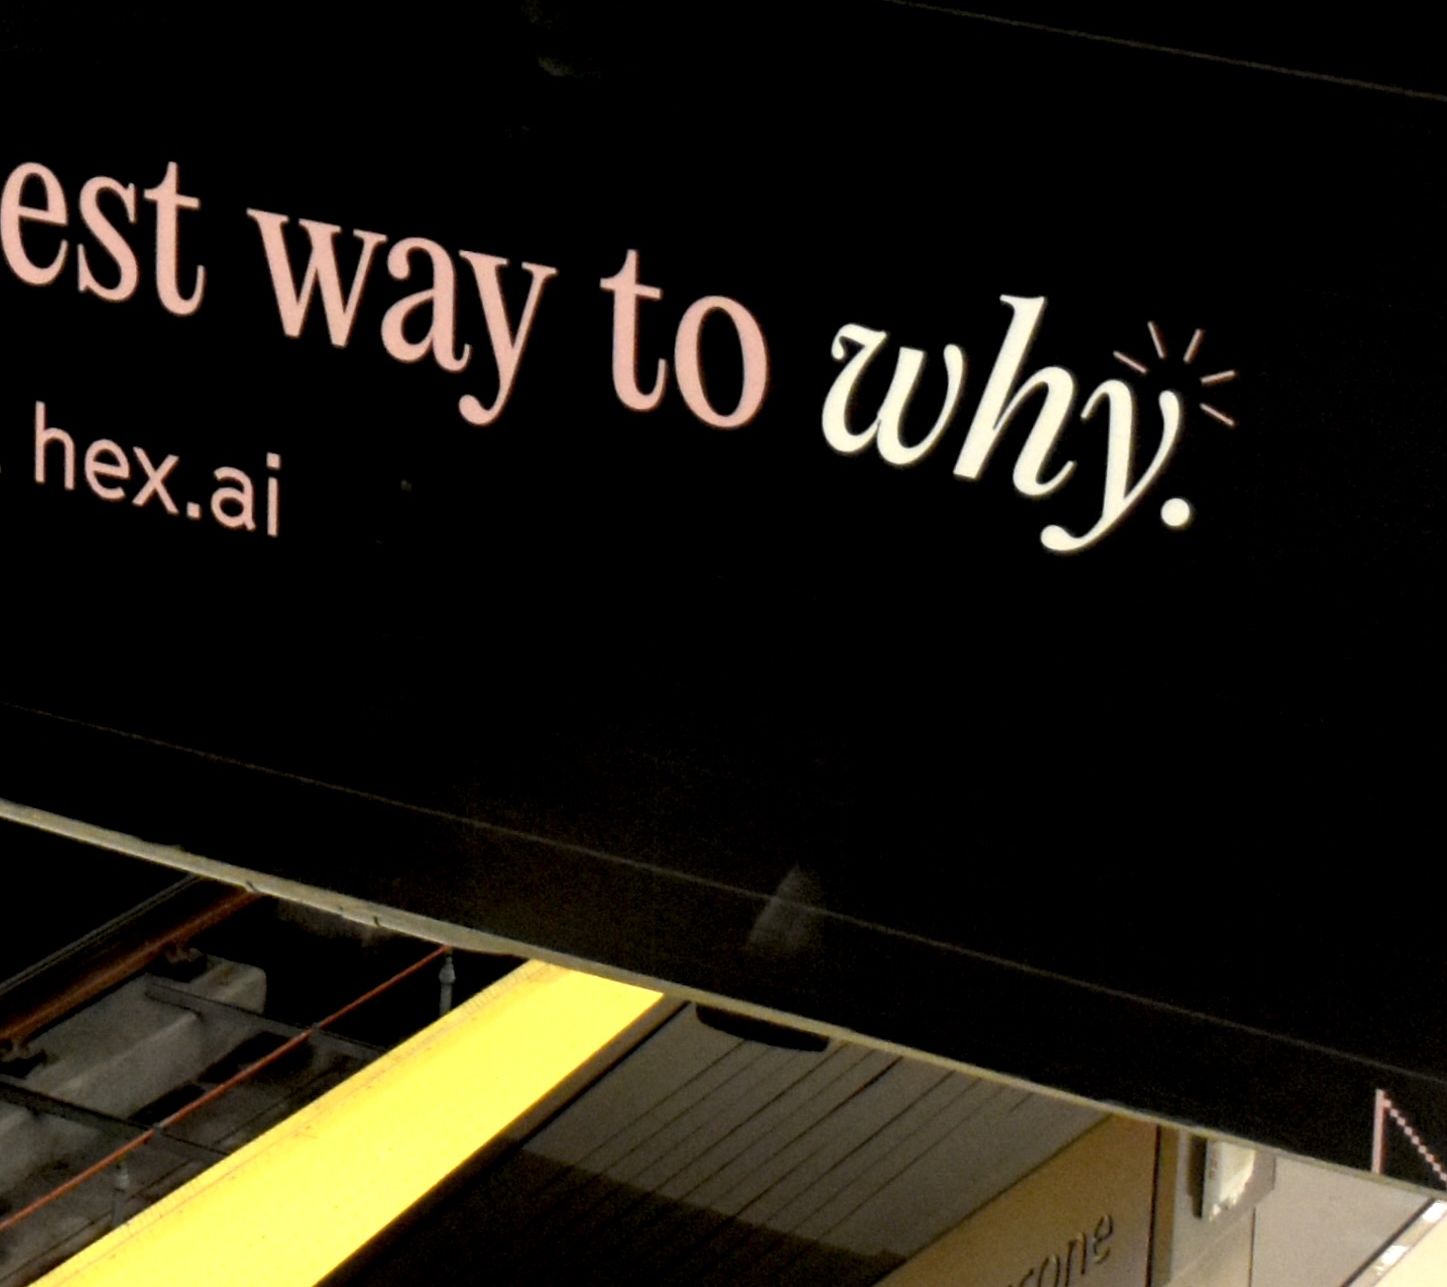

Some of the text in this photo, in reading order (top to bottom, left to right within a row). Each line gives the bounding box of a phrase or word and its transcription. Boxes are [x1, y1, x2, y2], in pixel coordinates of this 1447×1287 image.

[36, 402, 279, 535] hex.ai
[248, 209, 556, 424] way
[601, 250, 767, 427] to
[822, 295, 1190, 551] why.
